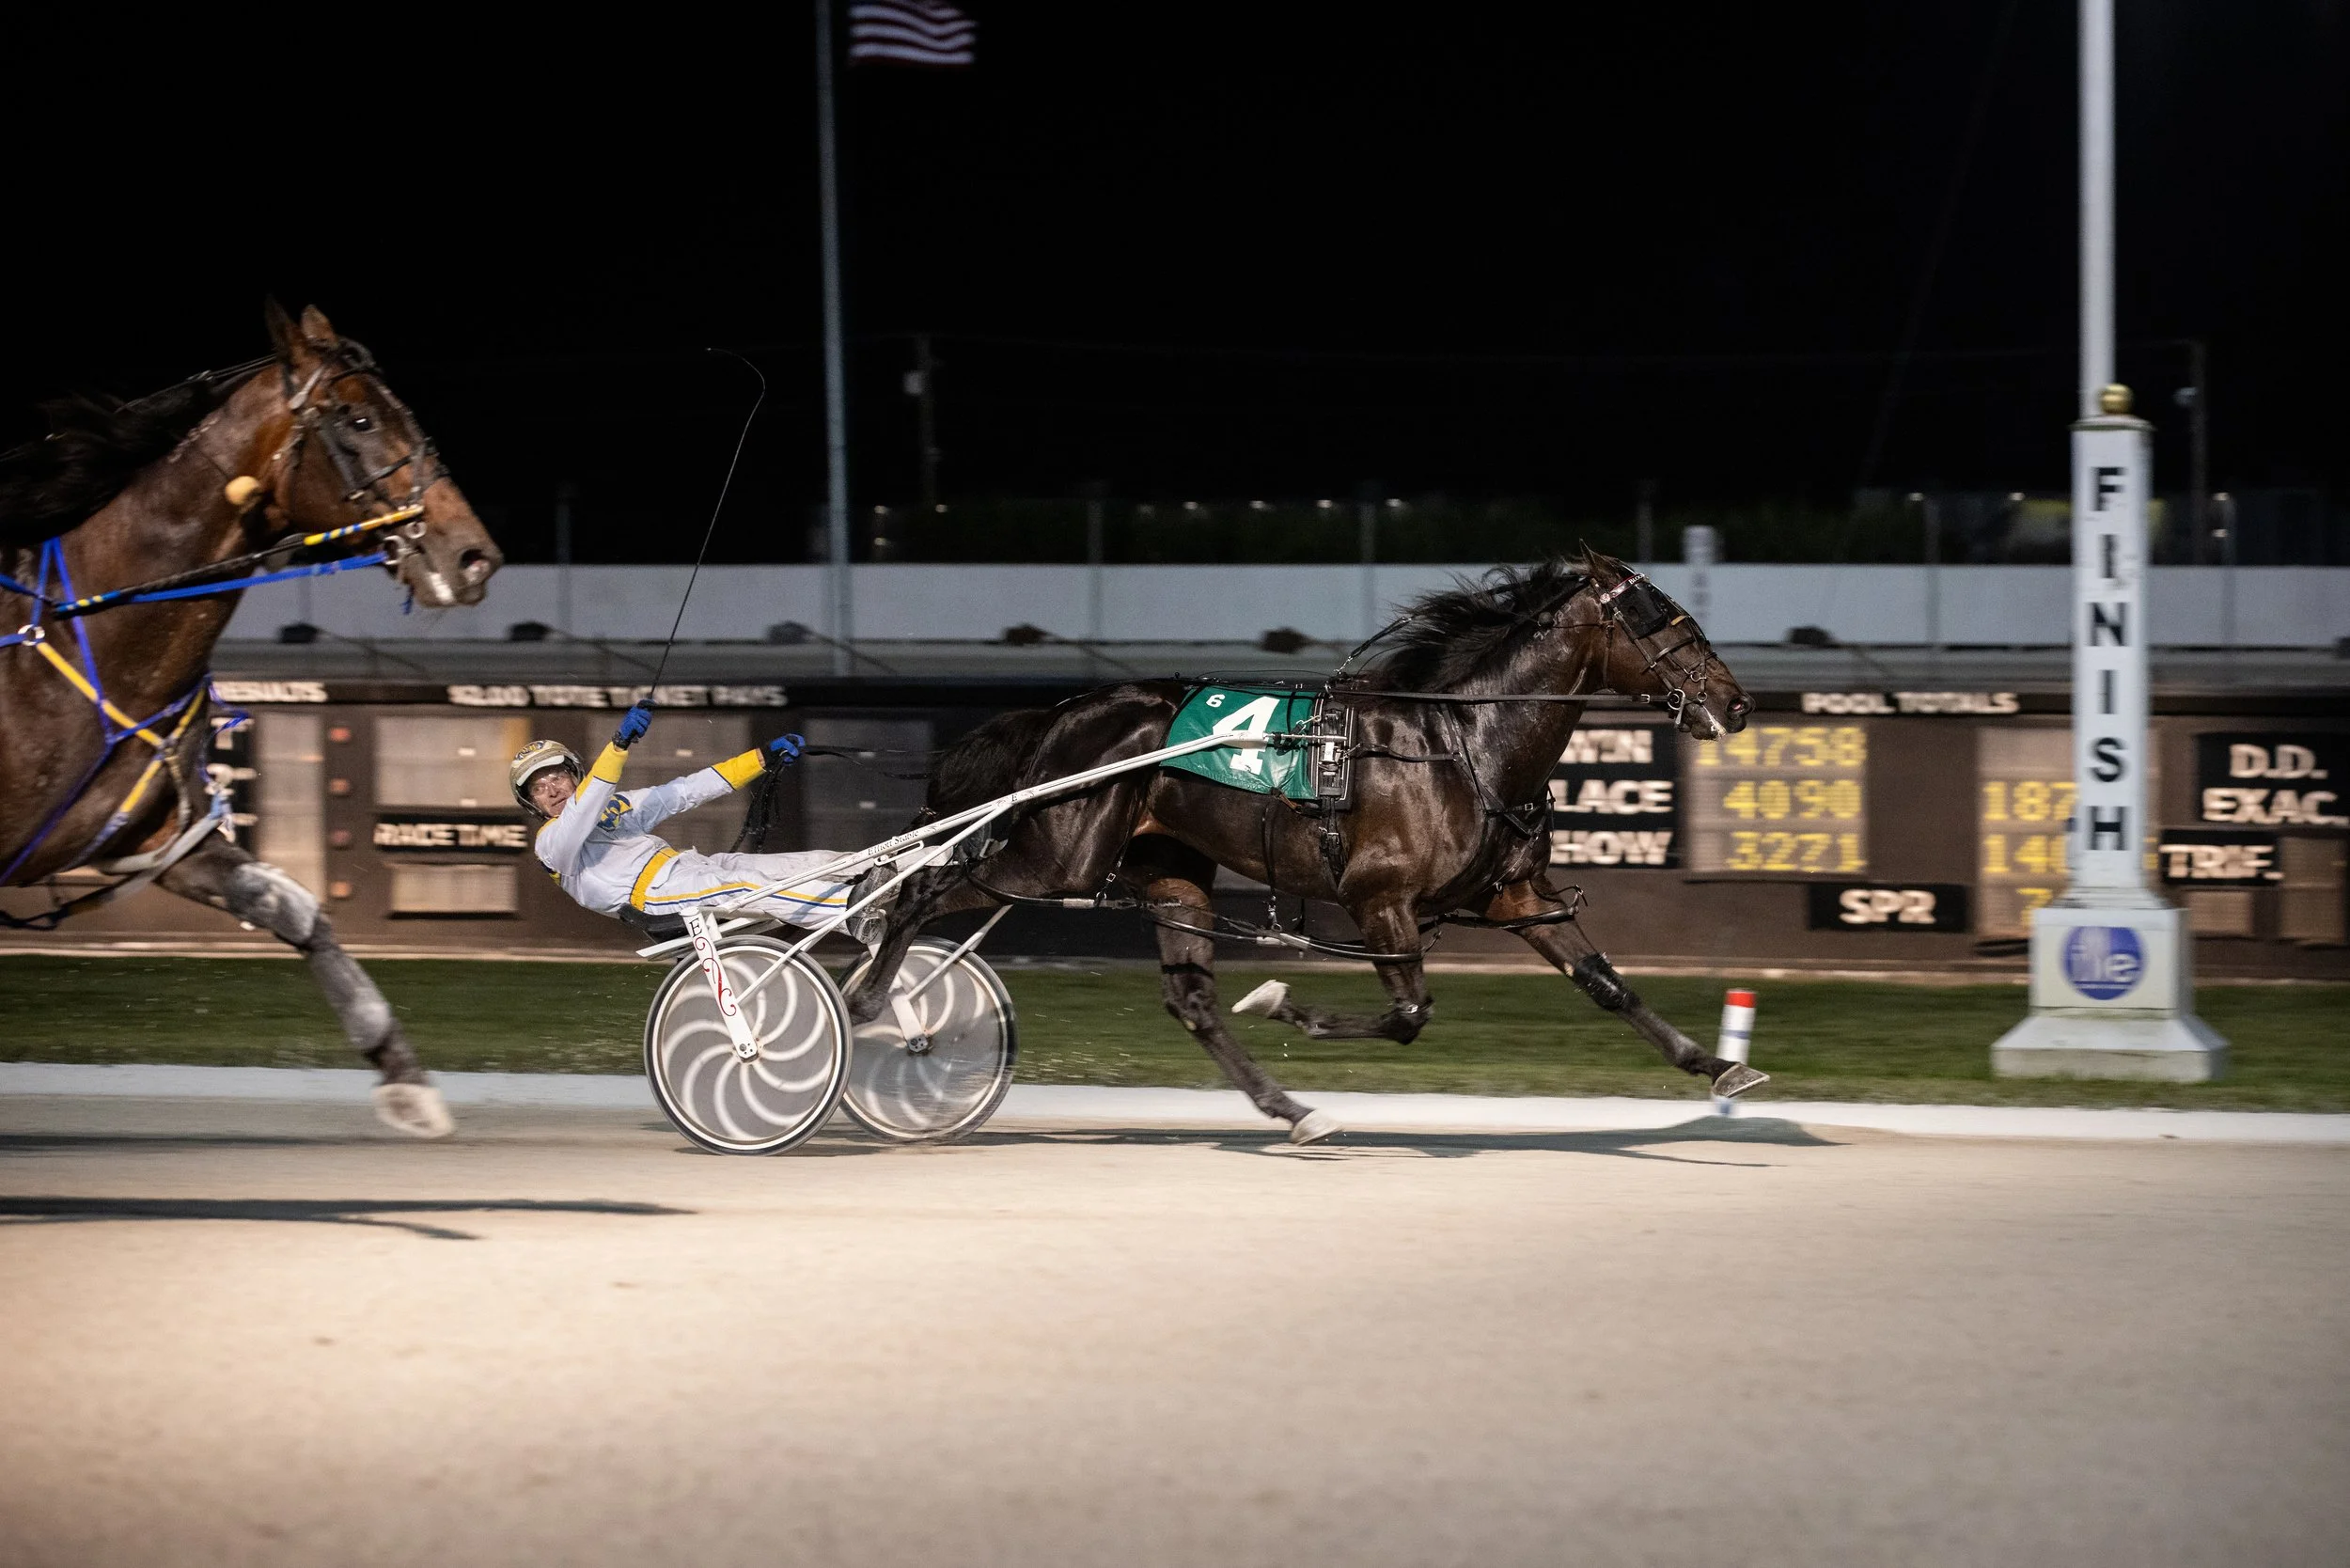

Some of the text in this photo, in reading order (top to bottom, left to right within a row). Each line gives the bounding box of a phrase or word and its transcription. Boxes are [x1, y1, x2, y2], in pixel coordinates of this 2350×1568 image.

[2084, 467, 2132, 851] FINISH
[1206, 694, 1225, 708] 6
[1802, 692, 2020, 713] POOL TOTALS
[1213, 696, 1280, 775] 4
[2229, 744, 2327, 778] D.D.
[1549, 779, 1674, 814] LACE
[2201, 788, 2349, 824] EXAC.
[374, 823, 528, 847] RACE TIME
[2159, 844, 2284, 880] TRIF.
[1839, 888, 1936, 924] SPR
[689, 917, 703, 937] E
